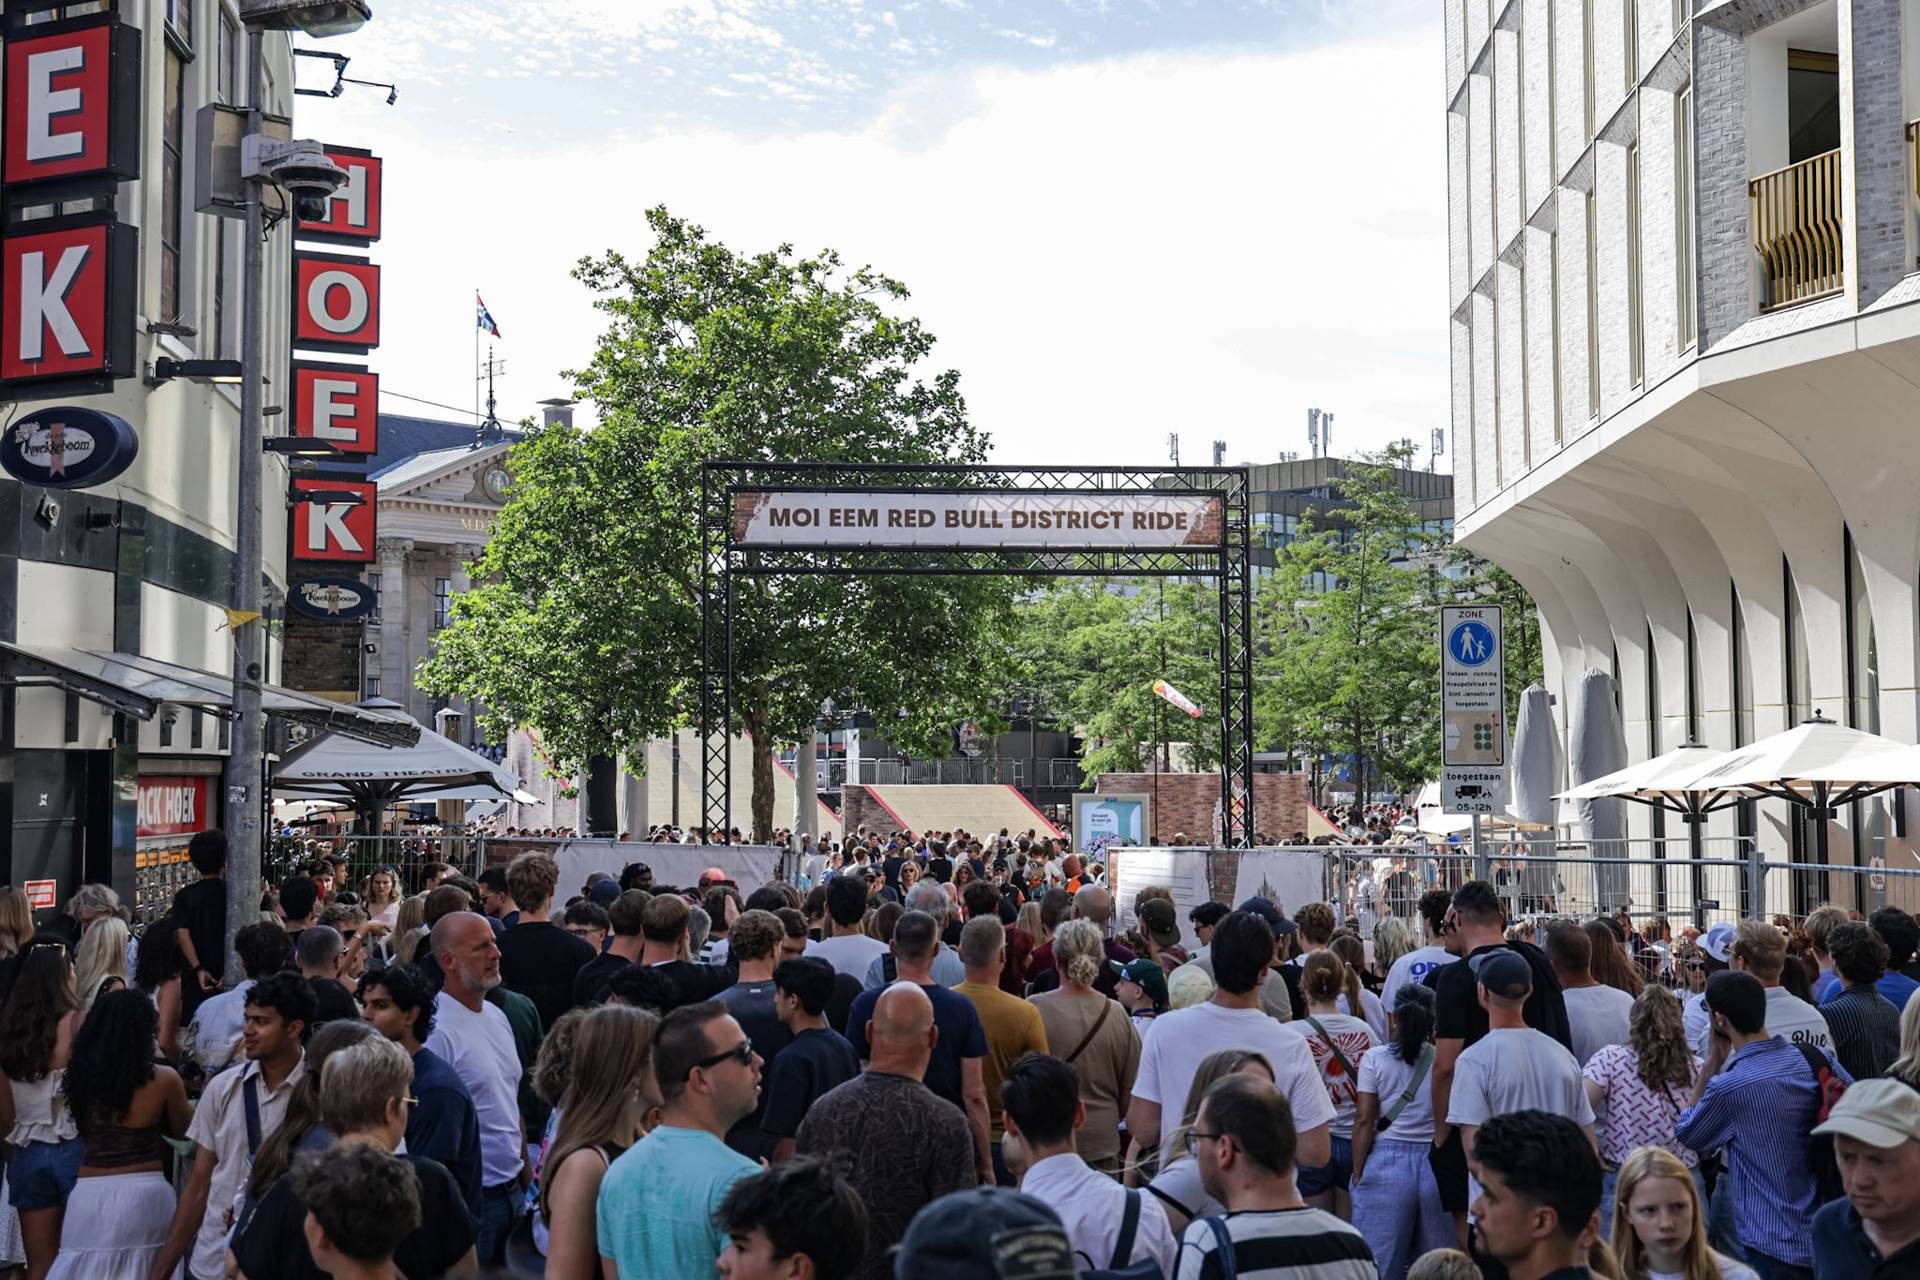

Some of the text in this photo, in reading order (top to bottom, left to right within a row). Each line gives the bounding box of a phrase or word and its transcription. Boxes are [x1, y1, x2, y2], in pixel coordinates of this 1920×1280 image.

[308, 165, 366, 551] HOEK
[769, 508, 1187, 530] MOI EEM RED BULL DISTRICT RIDE
[383, 768, 471, 777] THEATRE
[1447, 773, 1501, 782] toegestaan
[165, 786, 196, 824] HOEK
[1457, 803, 1492, 811] 05-12h
[1792, 1029, 1828, 1048] Blue
